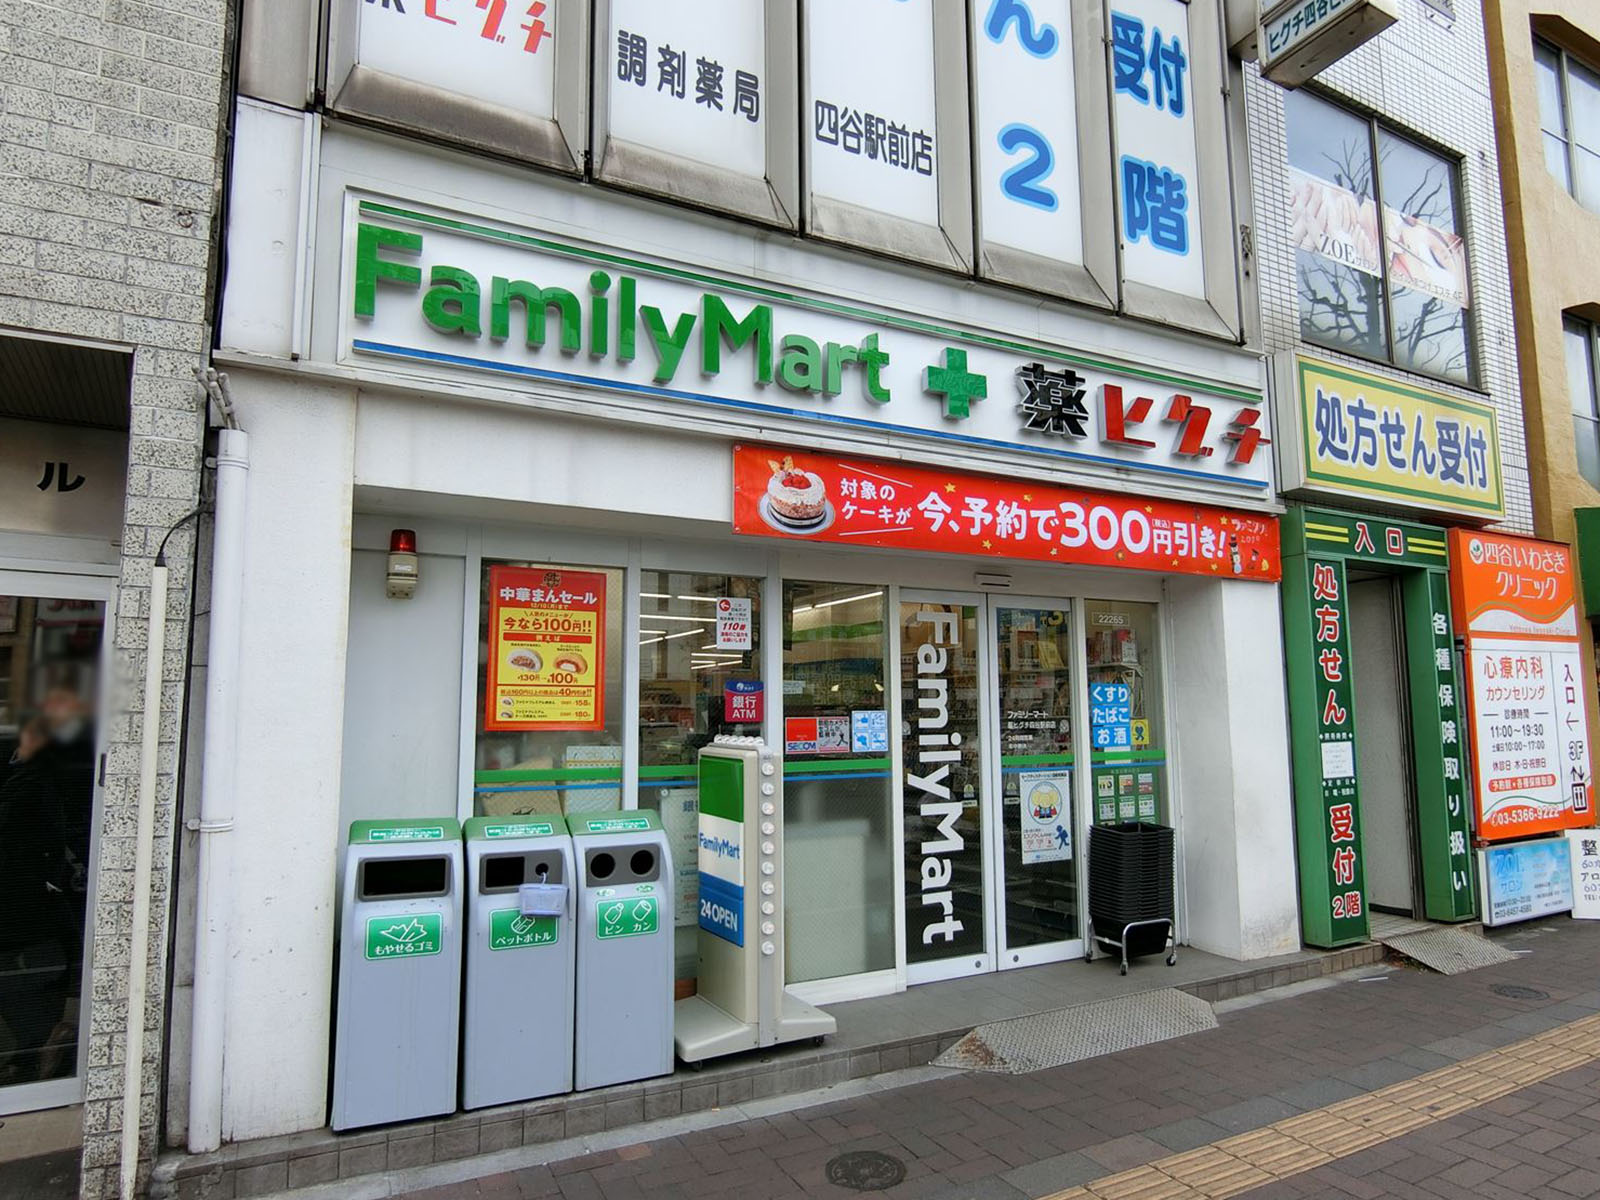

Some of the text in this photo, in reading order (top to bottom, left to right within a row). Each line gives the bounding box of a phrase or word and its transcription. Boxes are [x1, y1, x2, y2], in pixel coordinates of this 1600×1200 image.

[617, 29, 760, 123] 調剤薬局
[814, 99, 933, 176] 四谷駅前店
[354, 222, 893, 404] FamilyMart
[1315, 388, 1488, 490] 処方せん受付
[840, 477, 896, 501] 対象の
[841, 501, 913, 526] ケーキが
[1355, 522, 1405, 556] 入口
[1484, 542, 1566, 575] 四谷いわさき
[500, 586, 598, 605] 中華まんセール
[1495, 571, 1557, 600] クリニック
[504, 616, 592, 633] 今なら100円!!
[1098, 615, 1125, 624] 22265
[1312, 562, 1346, 726] 処方せん
[1484, 655, 1544, 680] 心療内科
[1093, 686, 1129, 702] くすり
[1486, 686, 1545, 702] カウンセリング
[1564, 664, 1576, 704] 入口
[732, 696, 757, 708] 銀行
[732, 709, 756, 719] ATM
[1007, 710, 1049, 719] ファミリーマート
[1093, 707, 1130, 724] たばこ
[787, 742, 817, 751] SECOM
[1097, 727, 1128, 744] お酒
[1432, 612, 1467, 891] 各種保険取り扱い
[907, 612, 965, 944] FamilyMart
[1497, 808, 1560, 826] 03-5366-9222
[699, 833, 740, 861] FamilyMart
[1329, 803, 1355, 886] 受付
[1332, 891, 1362, 918] 2階
[495, 932, 552, 945] ペットボトル
[633, 922, 651, 932] カン
[375, 941, 433, 956] もやせるゴミ
